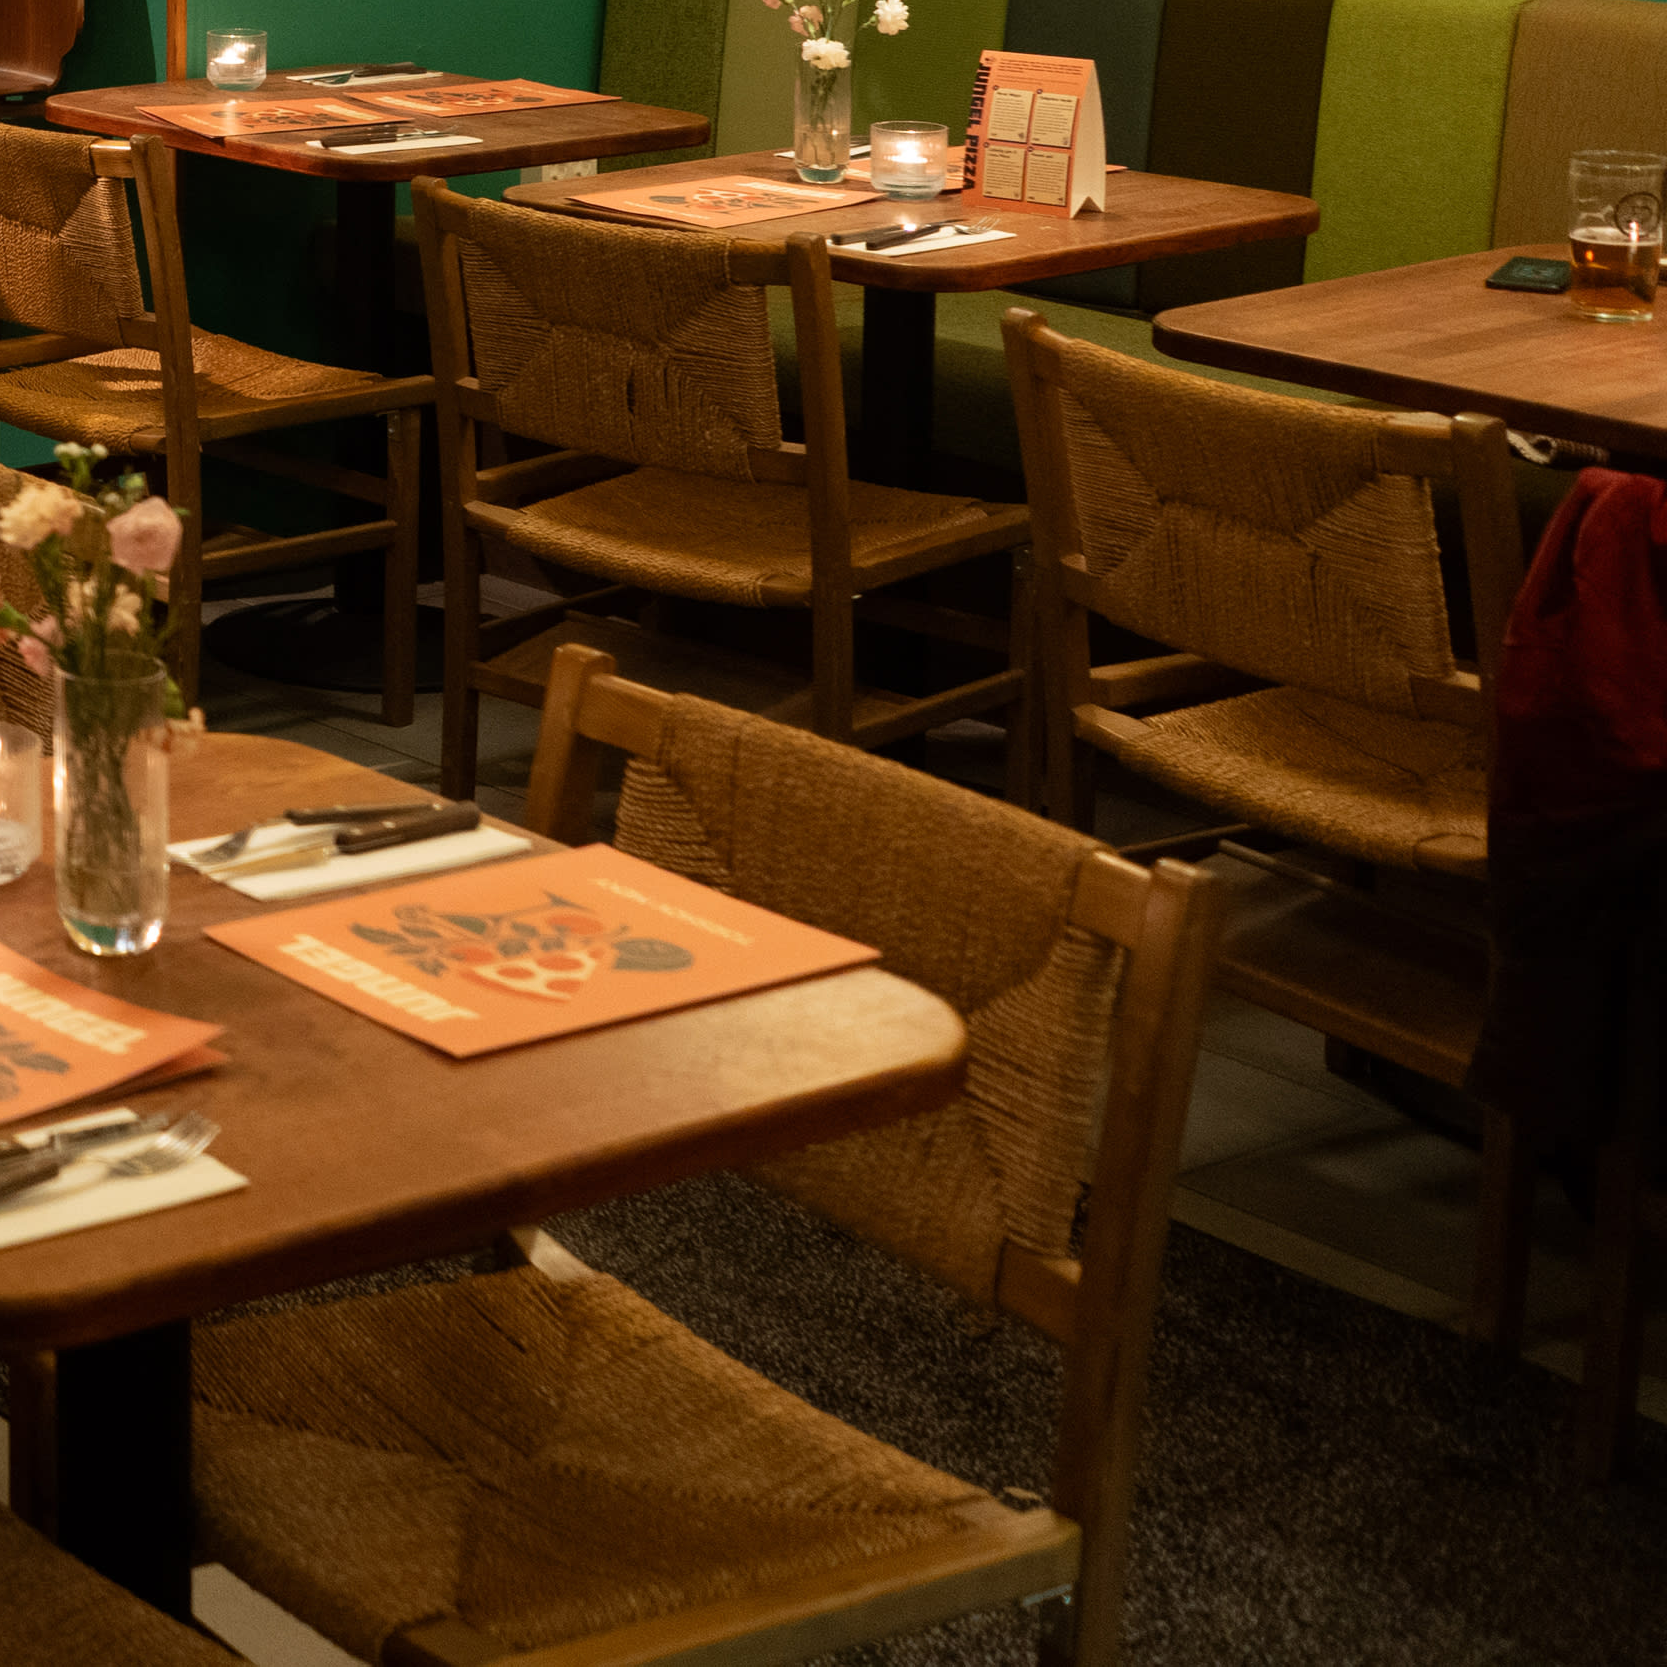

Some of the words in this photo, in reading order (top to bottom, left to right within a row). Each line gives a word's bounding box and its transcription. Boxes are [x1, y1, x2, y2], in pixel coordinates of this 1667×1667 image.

[968, 63, 991, 128] JUNGEL
[963, 135, 980, 190] PIZZA
[277, 934, 490, 1022] JUNGEL
